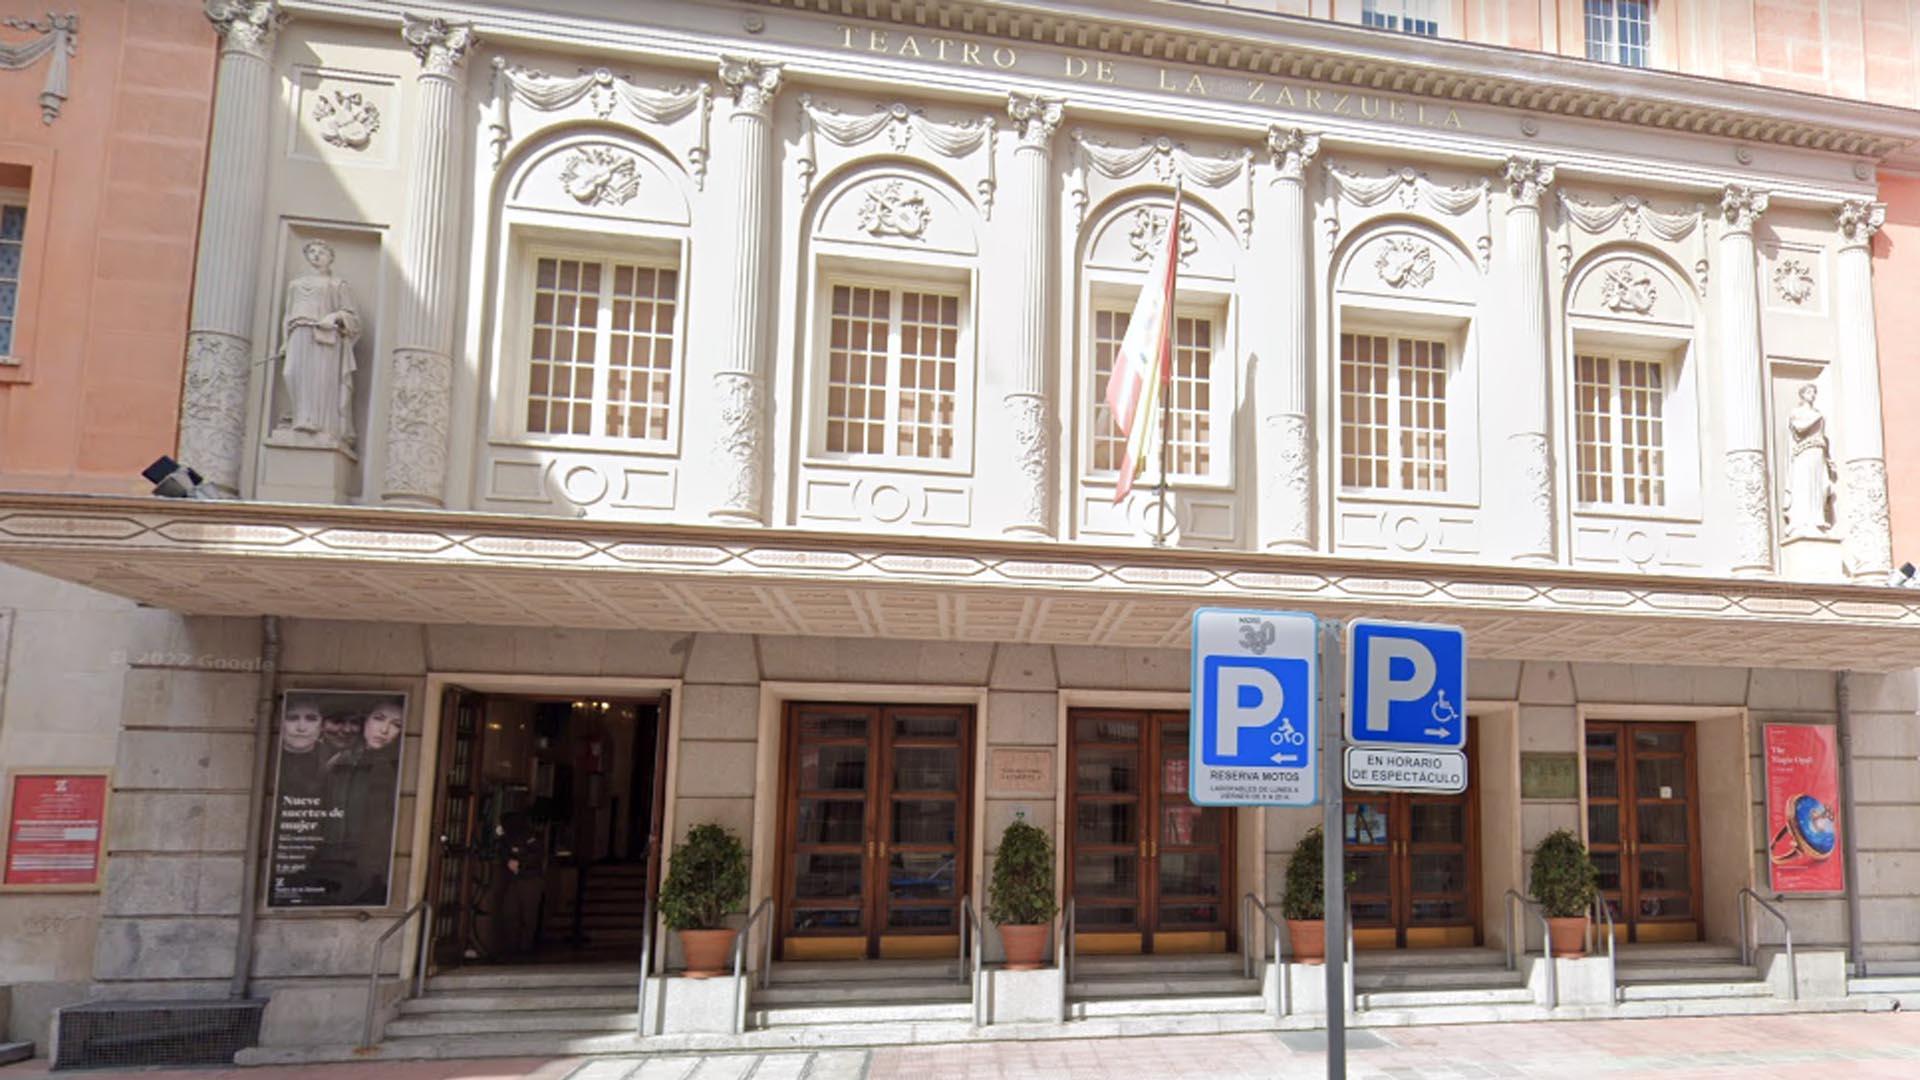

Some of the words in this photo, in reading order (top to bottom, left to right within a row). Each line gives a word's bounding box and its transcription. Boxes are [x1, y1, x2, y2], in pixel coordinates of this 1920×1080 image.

[838, 24, 1018, 68] TEATRO
[1065, 55, 1117, 82] DE
[1160, 68, 1208, 96] LA
[1248, 81, 1465, 128] ZARZUELA
[1368, 636, 1437, 731] P
[1217, 666, 1284, 756] P
[1367, 755, 1384, 766] EN
[1387, 757, 1443, 769] HORARIO
[1210, 770, 1260, 782] RESERVA
[1262, 772, 1300, 782] MOTOS
[1351, 769, 1369, 780] DE
[282, 796, 321, 806] Nueve
[328, 807, 345, 818] de
[280, 820, 319, 833] mujer
